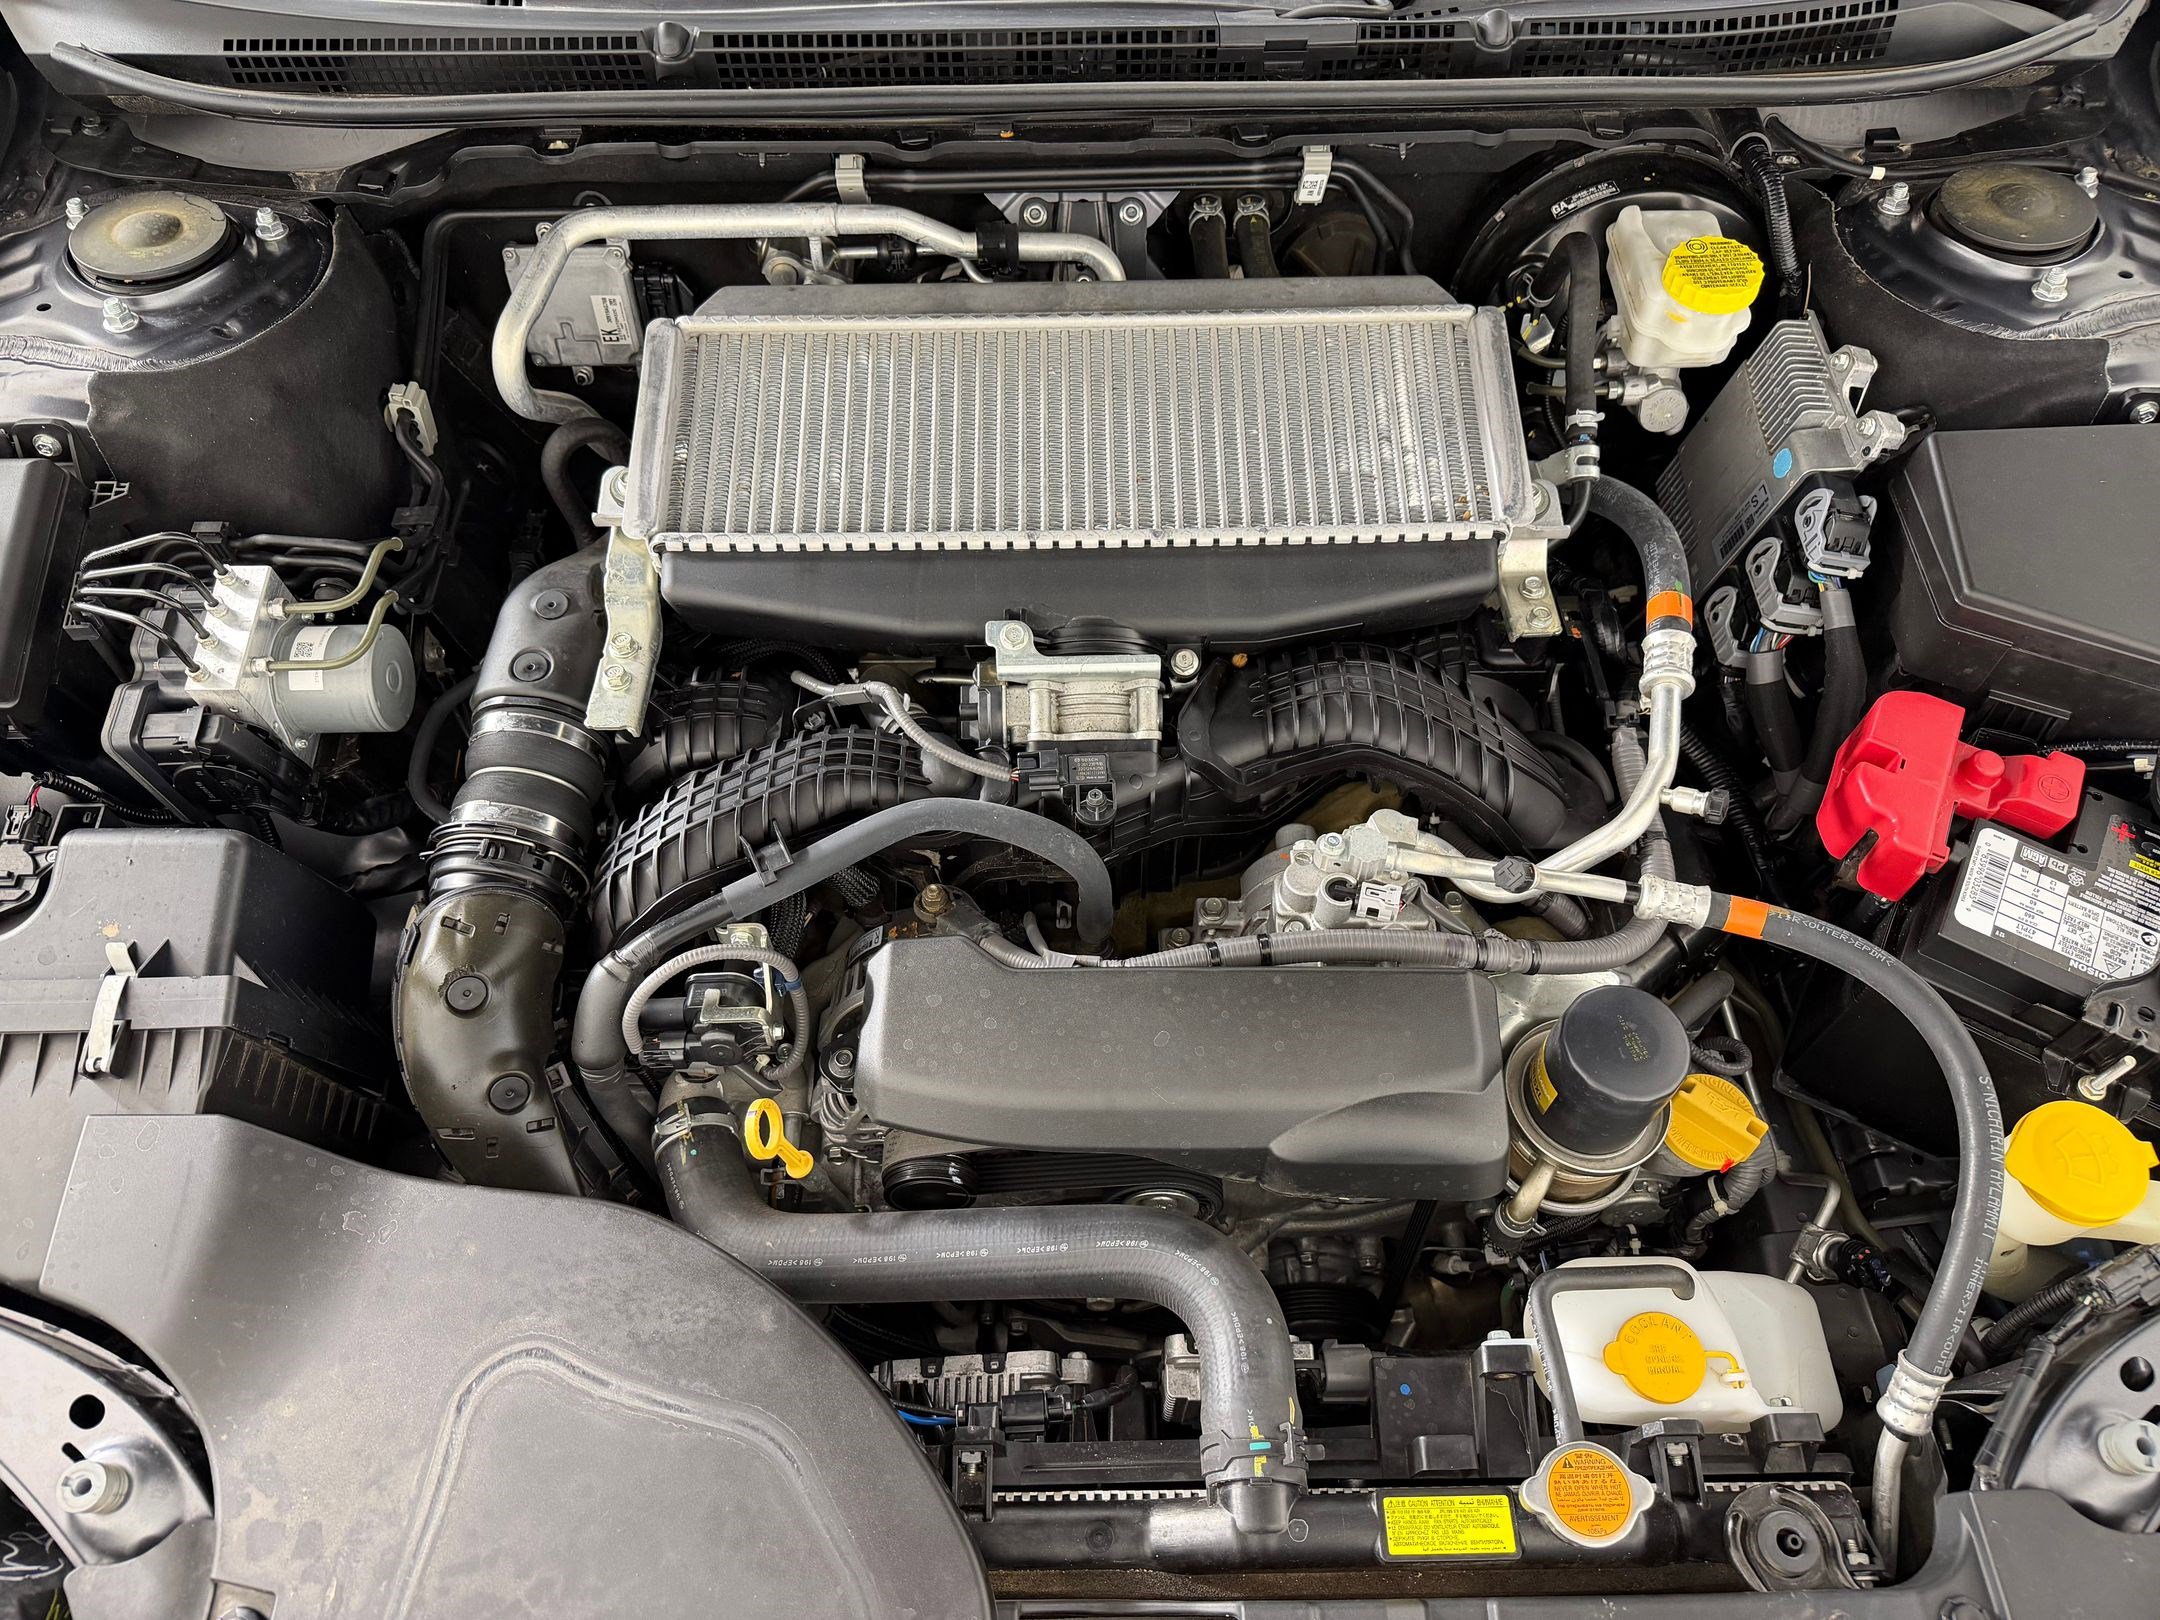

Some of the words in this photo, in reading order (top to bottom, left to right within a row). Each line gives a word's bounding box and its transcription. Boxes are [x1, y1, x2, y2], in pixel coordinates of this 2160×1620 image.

[601, 329, 620, 342] EK
[1975, 852, 1988, 876] 83996
[2021, 846, 2047, 866] AGM
[2050, 859, 2065, 871] Pb
[1968, 876, 1981, 900] 03285
[2069, 958, 2120, 980] OISON
[1671, 1126, 1700, 1155] OWNER'S
[936, 1250, 965, 1258] >EPDM<
[1017, 1246, 1044, 1254] >EPDM<
[1096, 1240, 1124, 1248] >EPDM<
[853, 1255, 882, 1264] >EPDM<
[1230, 1311, 1245, 1344] >EPDM<
[1624, 1315, 1692, 1344] COOLANT
